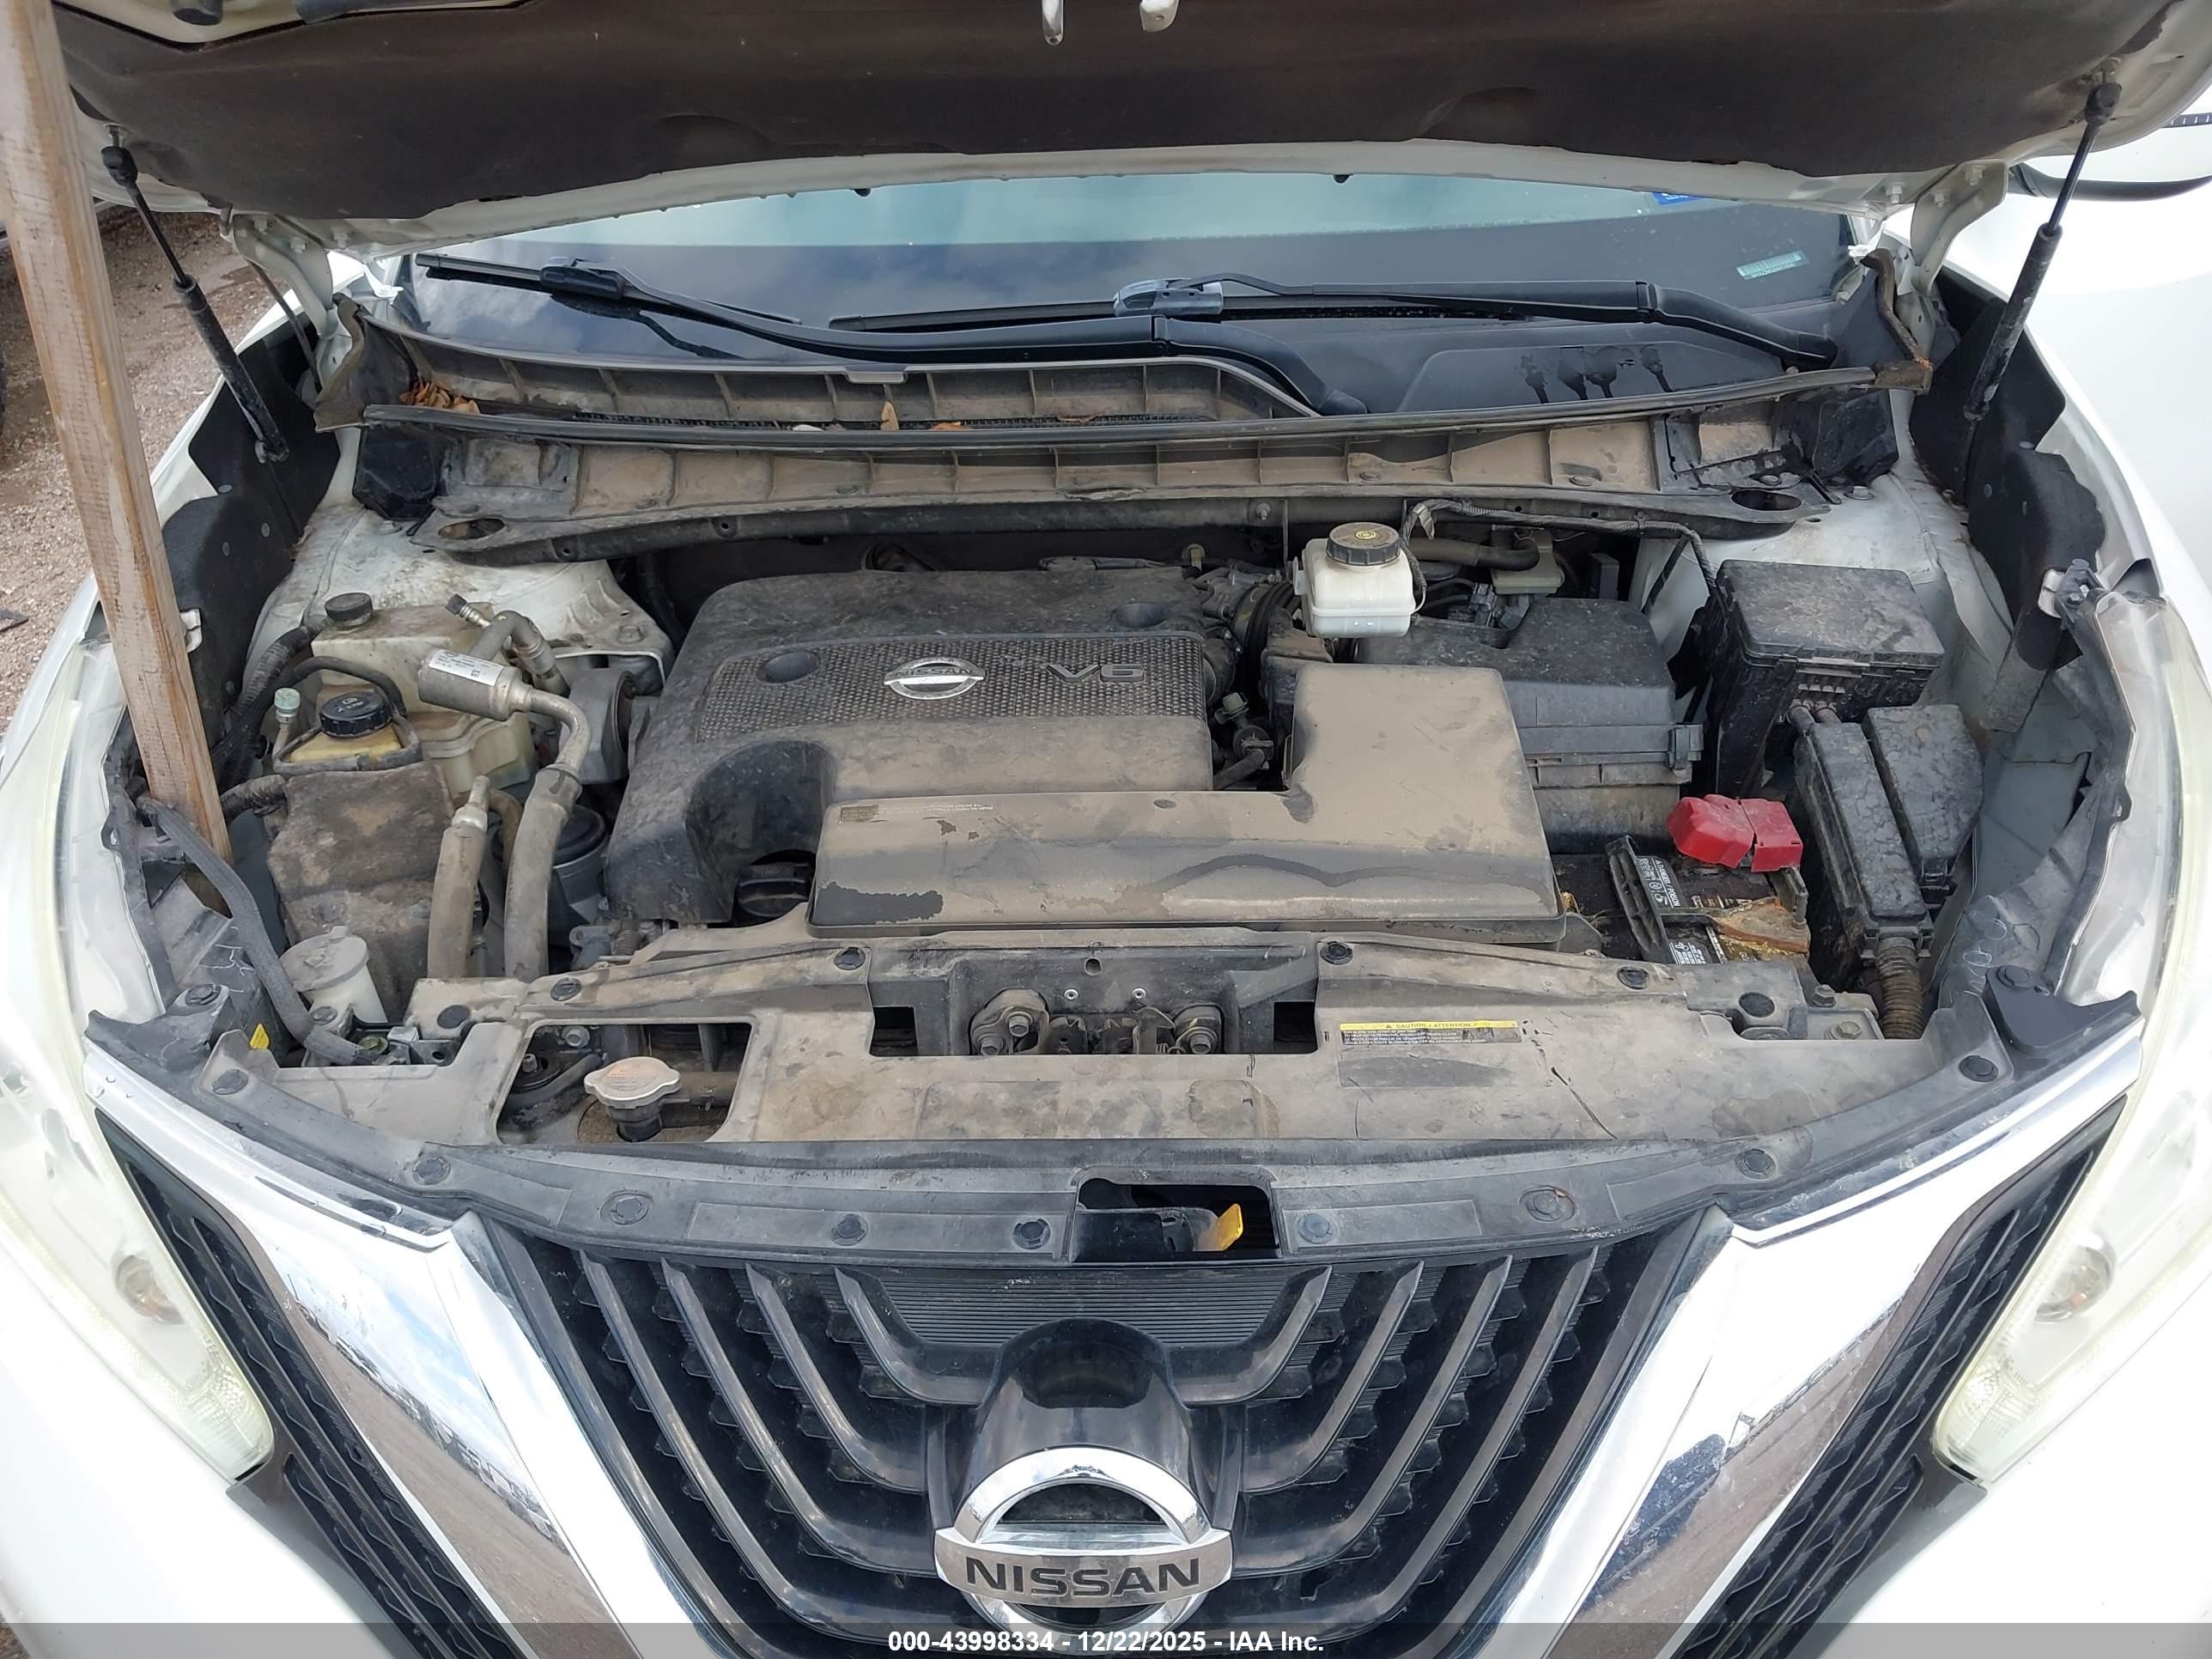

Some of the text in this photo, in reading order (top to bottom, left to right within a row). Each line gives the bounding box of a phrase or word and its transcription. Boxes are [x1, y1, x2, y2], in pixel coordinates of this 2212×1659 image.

[893, 666, 974, 678] NISSAN
[1042, 663, 1145, 684] V6
[1657, 864, 1672, 884] DANGER
[1667, 888, 1681, 907] POISON
[966, 1557, 1200, 1597] NISSAN
